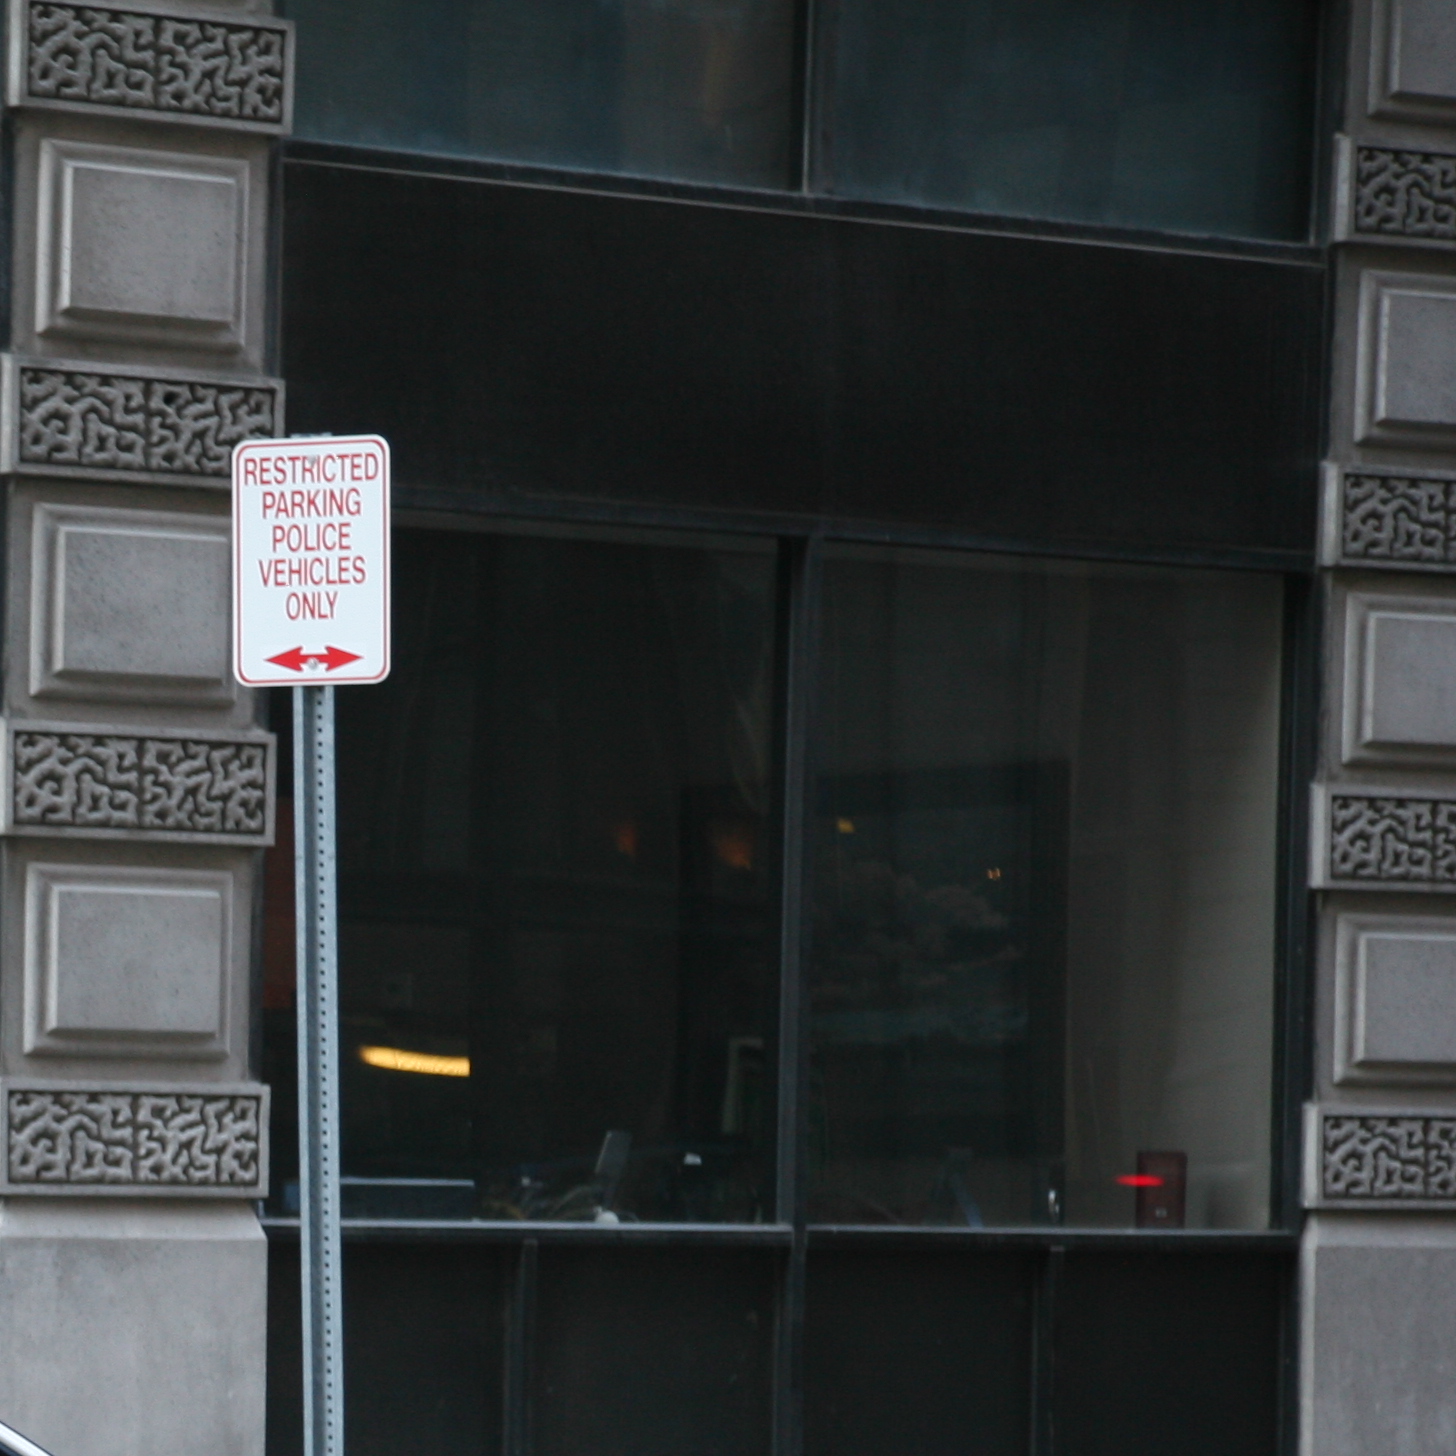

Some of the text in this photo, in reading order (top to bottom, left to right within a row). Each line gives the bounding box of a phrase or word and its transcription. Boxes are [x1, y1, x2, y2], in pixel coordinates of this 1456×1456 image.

[244, 453, 379, 486] RESTRICTED
[262, 488, 361, 519] PARKING
[272, 523, 352, 552] POLICE
[258, 556, 366, 587] VEHICLES
[285, 591, 339, 620] ONLY
